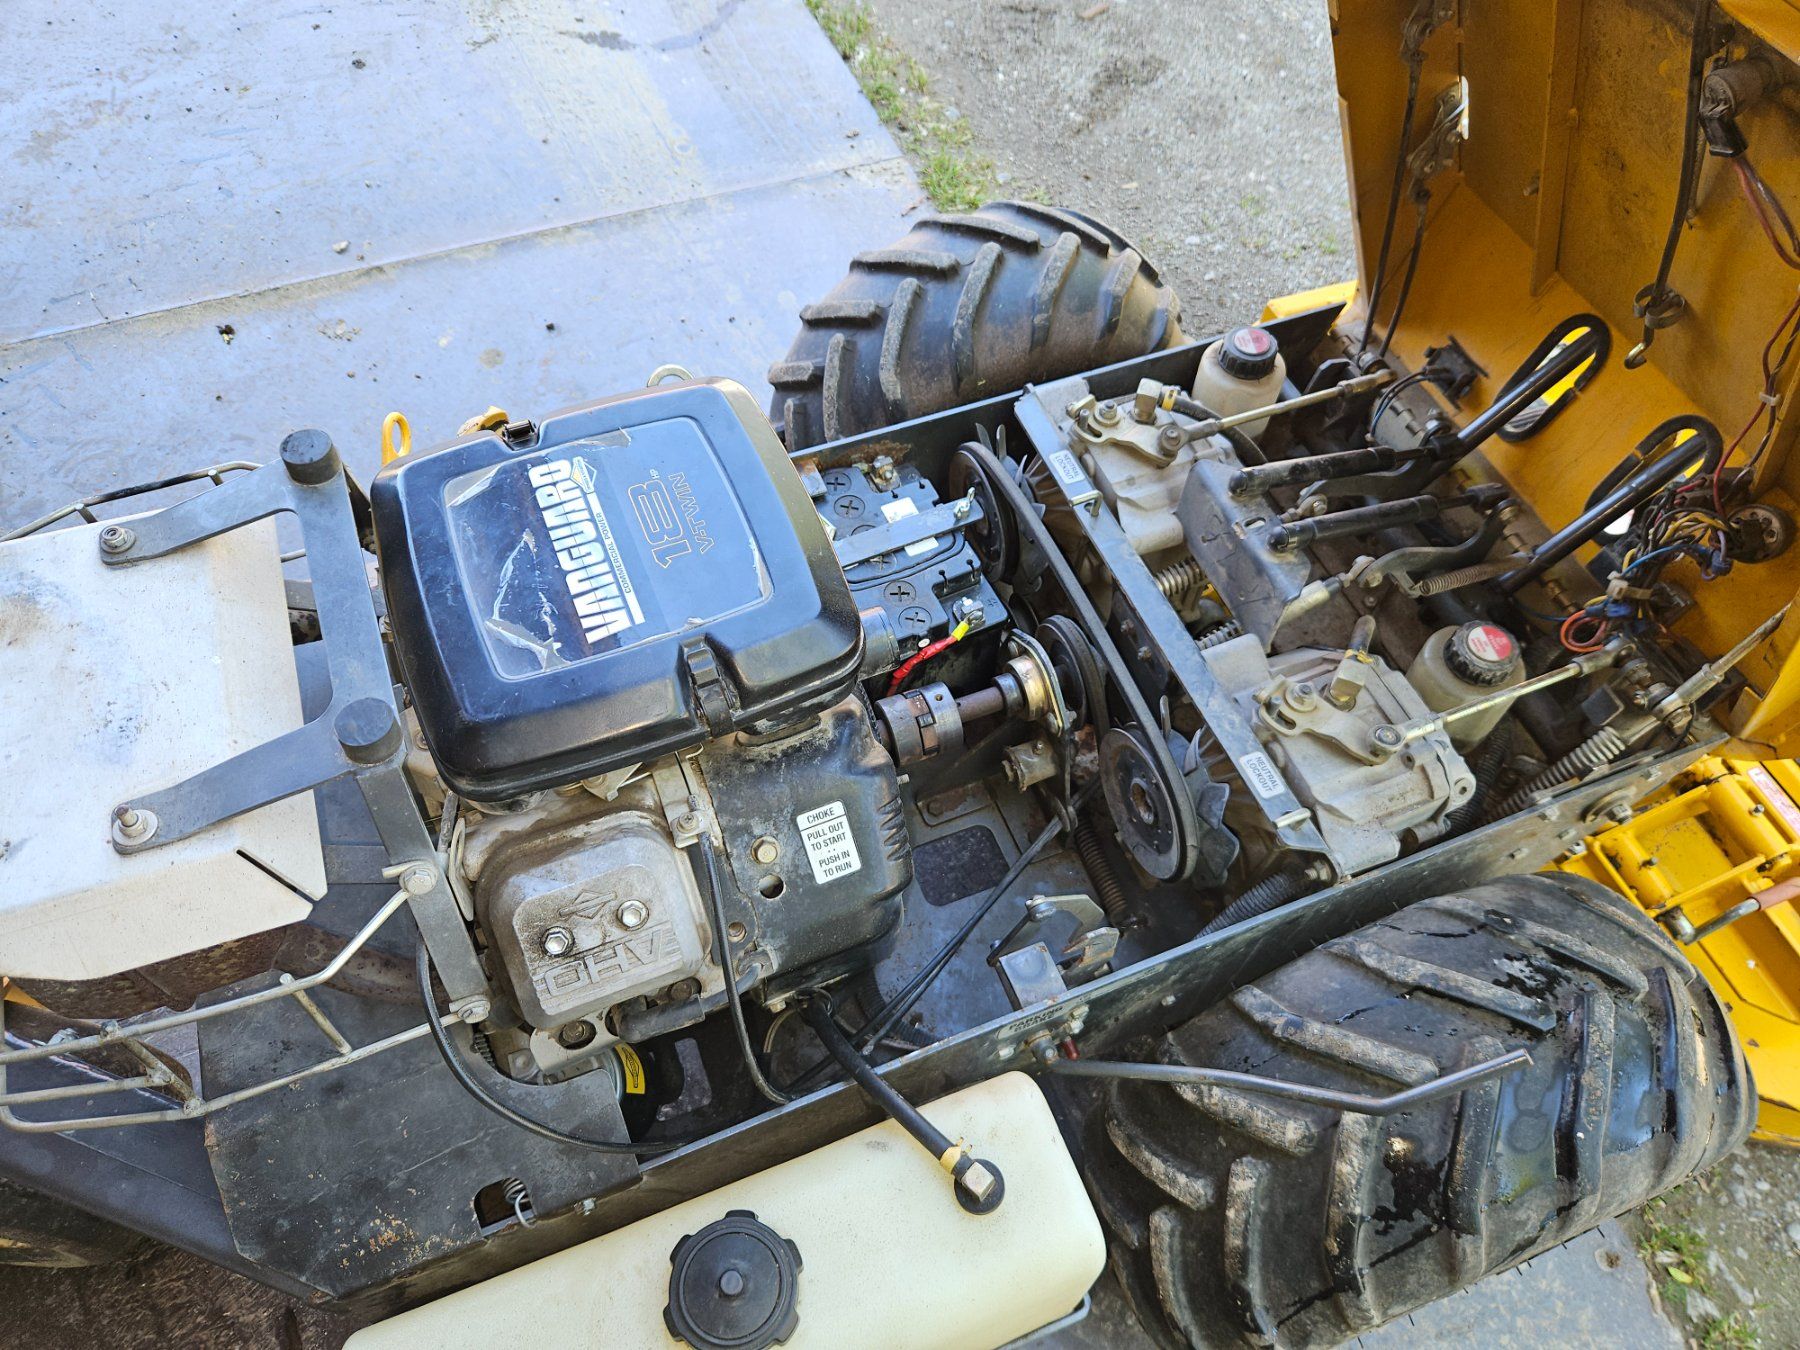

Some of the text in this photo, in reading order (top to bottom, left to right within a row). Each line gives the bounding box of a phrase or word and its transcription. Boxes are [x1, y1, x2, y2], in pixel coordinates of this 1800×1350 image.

[628, 480, 692, 568] 18
[668, 472, 715, 554] V-TWIN
[528, 459, 632, 644] VANGUARD
[595, 512, 632, 594] COMMERCIAL POWER
[1246, 759, 1273, 791] LOCKOUT
[1255, 756, 1279, 789] NEUTRAL
[806, 807, 835, 824] CHOKE
[807, 821, 844, 841] PULL OUT
[811, 832, 847, 852] TO START
[819, 849, 851, 868] PUSH IN
[823, 861, 852, 878] TO RUN
[544, 929, 663, 997] OHV
